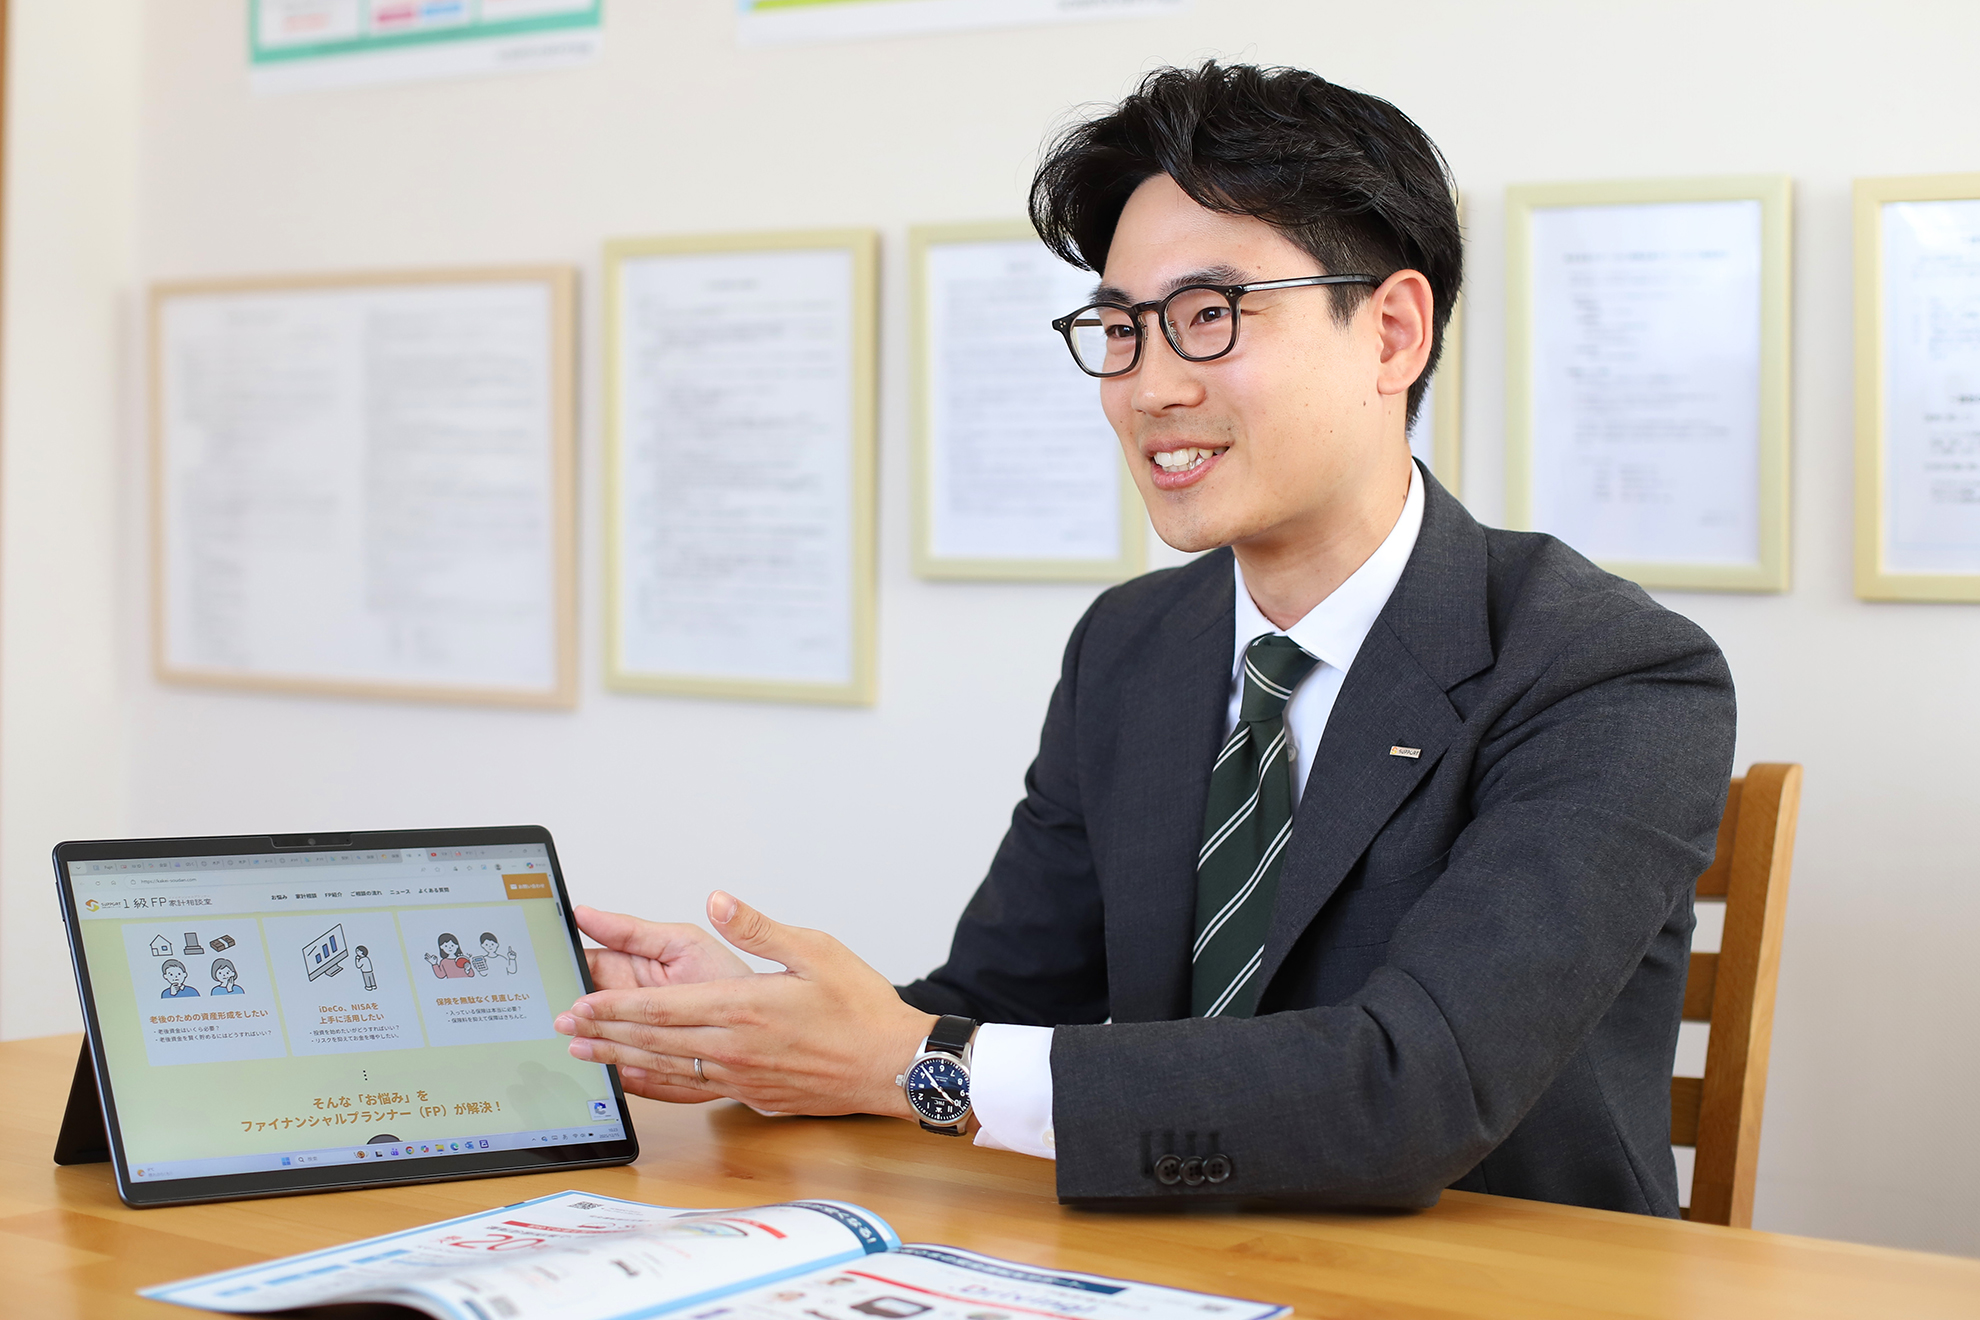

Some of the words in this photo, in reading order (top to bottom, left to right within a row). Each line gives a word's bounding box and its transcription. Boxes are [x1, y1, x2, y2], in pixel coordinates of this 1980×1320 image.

[149, 1009, 269, 1024] 老後のための資産形成をしたい
[319, 1013, 385, 1025] 上手に活用したい
[928, 1066, 934, 1074] 5
[950, 1069, 956, 1077] 7
[957, 1078, 963, 1086] 8
[918, 1092, 924, 1101] 2
[959, 1089, 965, 1097] 9
[312, 1089, 429, 1110] そんな「お悩み」を
